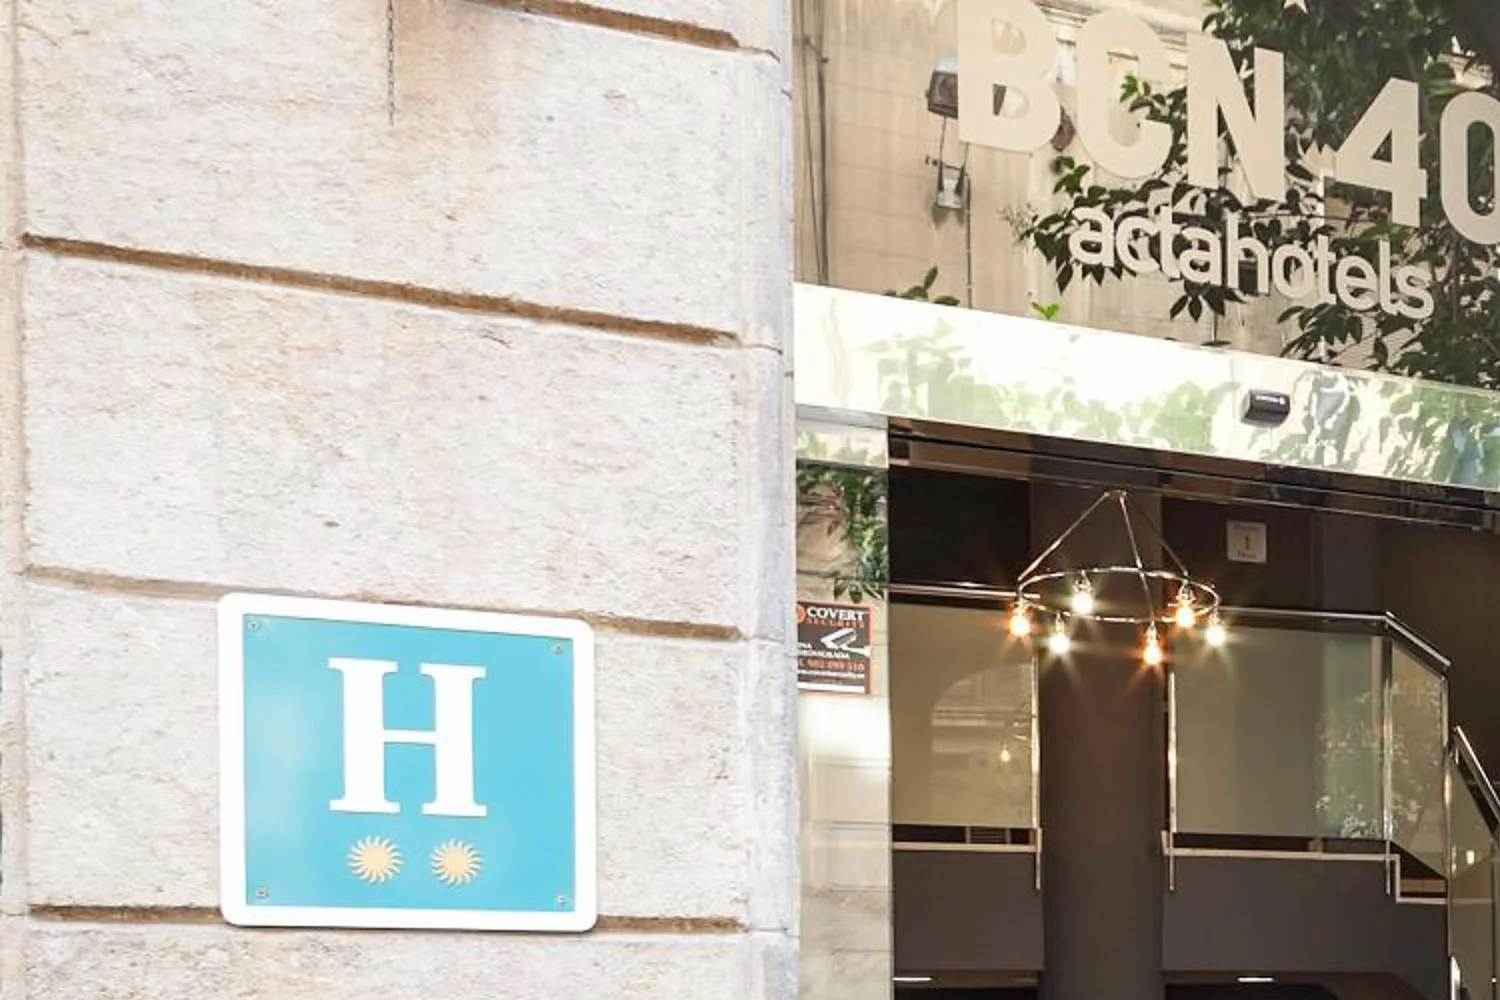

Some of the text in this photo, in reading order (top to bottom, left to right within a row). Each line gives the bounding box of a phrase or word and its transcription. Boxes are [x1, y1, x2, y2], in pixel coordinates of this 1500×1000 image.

[958, 0, 1284, 201] BCN
[1069, 201, 1435, 319] actahotels
[807, 606, 865, 620] COVERT
[328, 657, 488, 817] H
